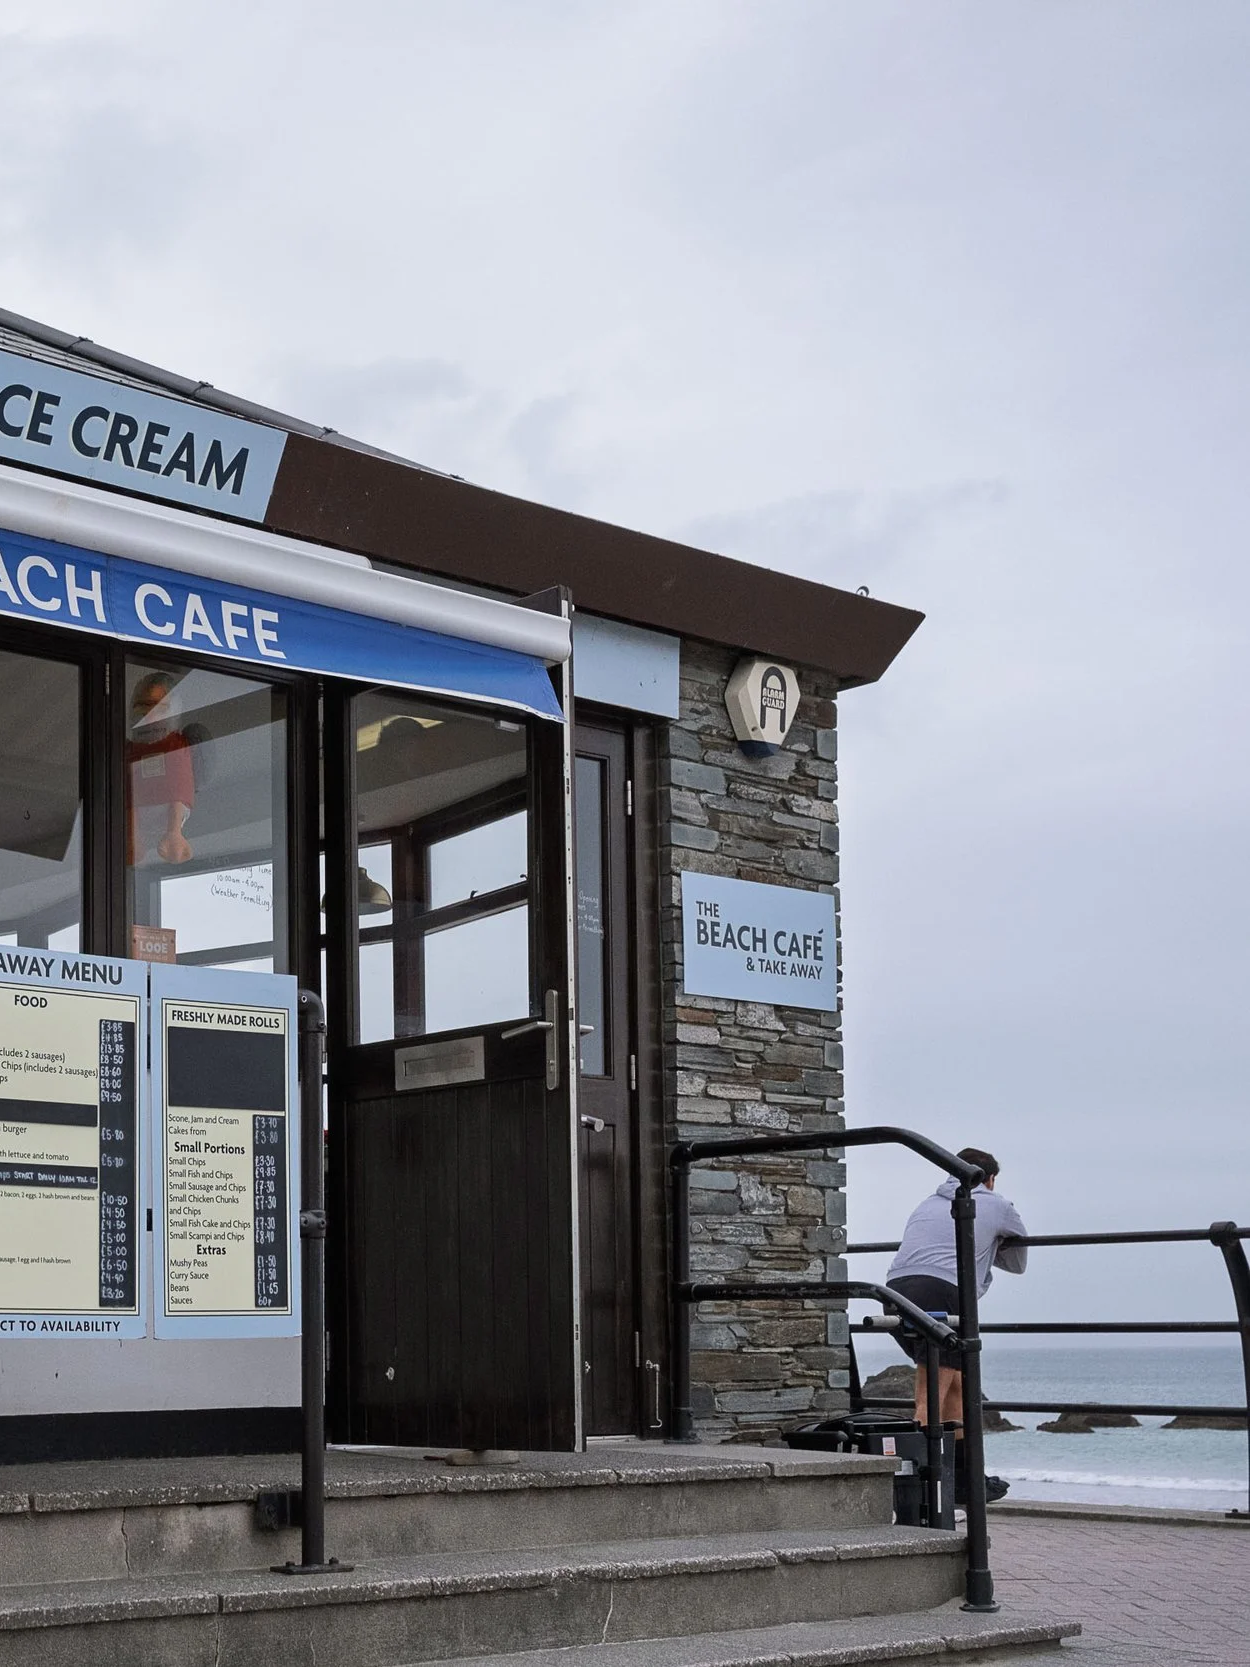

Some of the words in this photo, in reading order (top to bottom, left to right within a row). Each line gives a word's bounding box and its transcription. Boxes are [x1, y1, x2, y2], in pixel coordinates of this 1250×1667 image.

[72, 406, 250, 496] CREAM
[134, 583, 287, 660] CAFE
[763, 688, 784, 700] ALARM
[762, 697, 784, 709] GUARD
[697, 901, 719, 918] THE
[697, 920, 767, 954] BEACH
[773, 928, 823, 961] CAFÉ
[140, 941, 168, 954] LOOE
[62, 960, 122, 985] MENU
[746, 957, 755, 971] &
[759, 958, 787, 975] TAKE
[790, 962, 822, 980] AWAY
[14, 995, 47, 1008] FOOD
[172, 1010, 215, 1022] FRESHLY
[218, 1015, 246, 1025] MADE
[250, 1017, 280, 1028] ROLLS
[25, 1050, 29, 1058] 2
[31, 1051, 65, 1063] sausages)
[3, 1123, 27, 1135] burger
[169, 1126, 188, 1135] Cakes
[190, 1127, 206, 1135] from
[175, 1142, 201, 1152] Small
[205, 1143, 245, 1154] Portions
[169, 1157, 186, 1165] Small
[188, 1157, 206, 1166] Chips
[169, 1182, 186, 1190] Small
[188, 1182, 214, 1193] Sausage
[215, 1183, 227, 1191] and
[228, 1183, 246, 1192] Chips
[170, 1207, 181, 1215] and
[183, 1207, 201, 1216] Chips
[189, 1232, 212, 1242] Scampi
[227, 1233, 245, 1242] Chips
[197, 1244, 226, 1255] Extras
[19, 1321, 36, 1331] TO
[41, 1321, 121, 1332] AVAILABILITY
